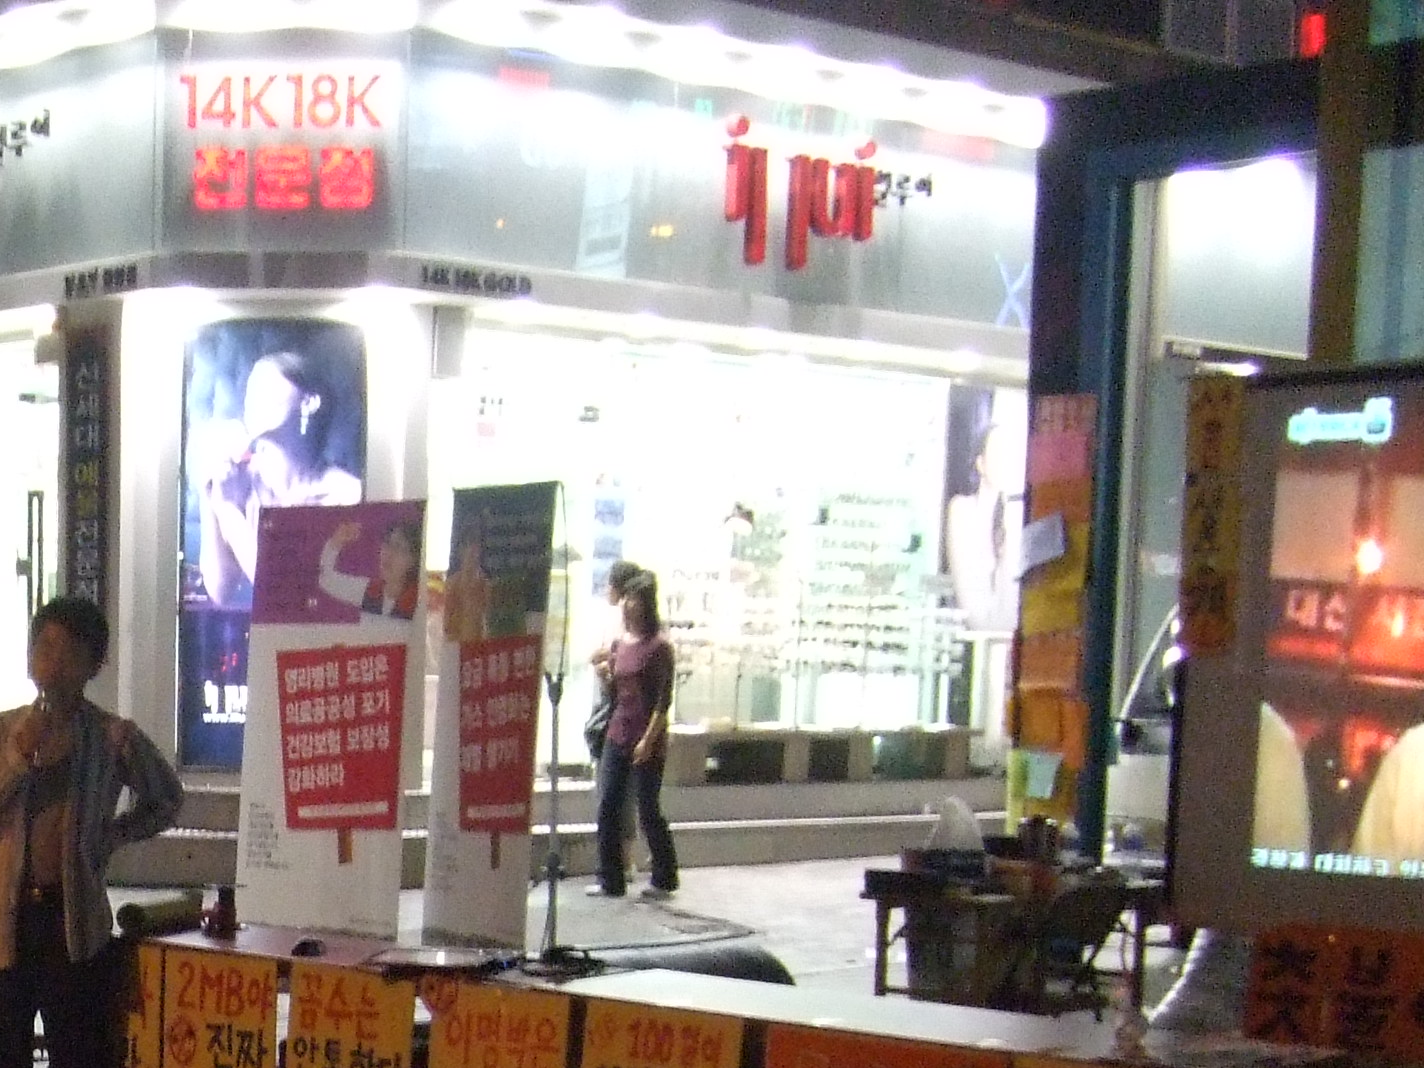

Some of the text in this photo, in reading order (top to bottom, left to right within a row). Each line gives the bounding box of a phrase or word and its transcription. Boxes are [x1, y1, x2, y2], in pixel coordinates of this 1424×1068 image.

[193, 146, 375, 210] 전문점
[346, 653, 389, 684] 도입은
[285, 688, 390, 725] 의료공공성 포기
[286, 721, 390, 760] 건강보험 보장성
[287, 762, 346, 794] 강화하라
[177, 960, 273, 1022] 2MB야
[298, 972, 380, 1041] 꼼수는
